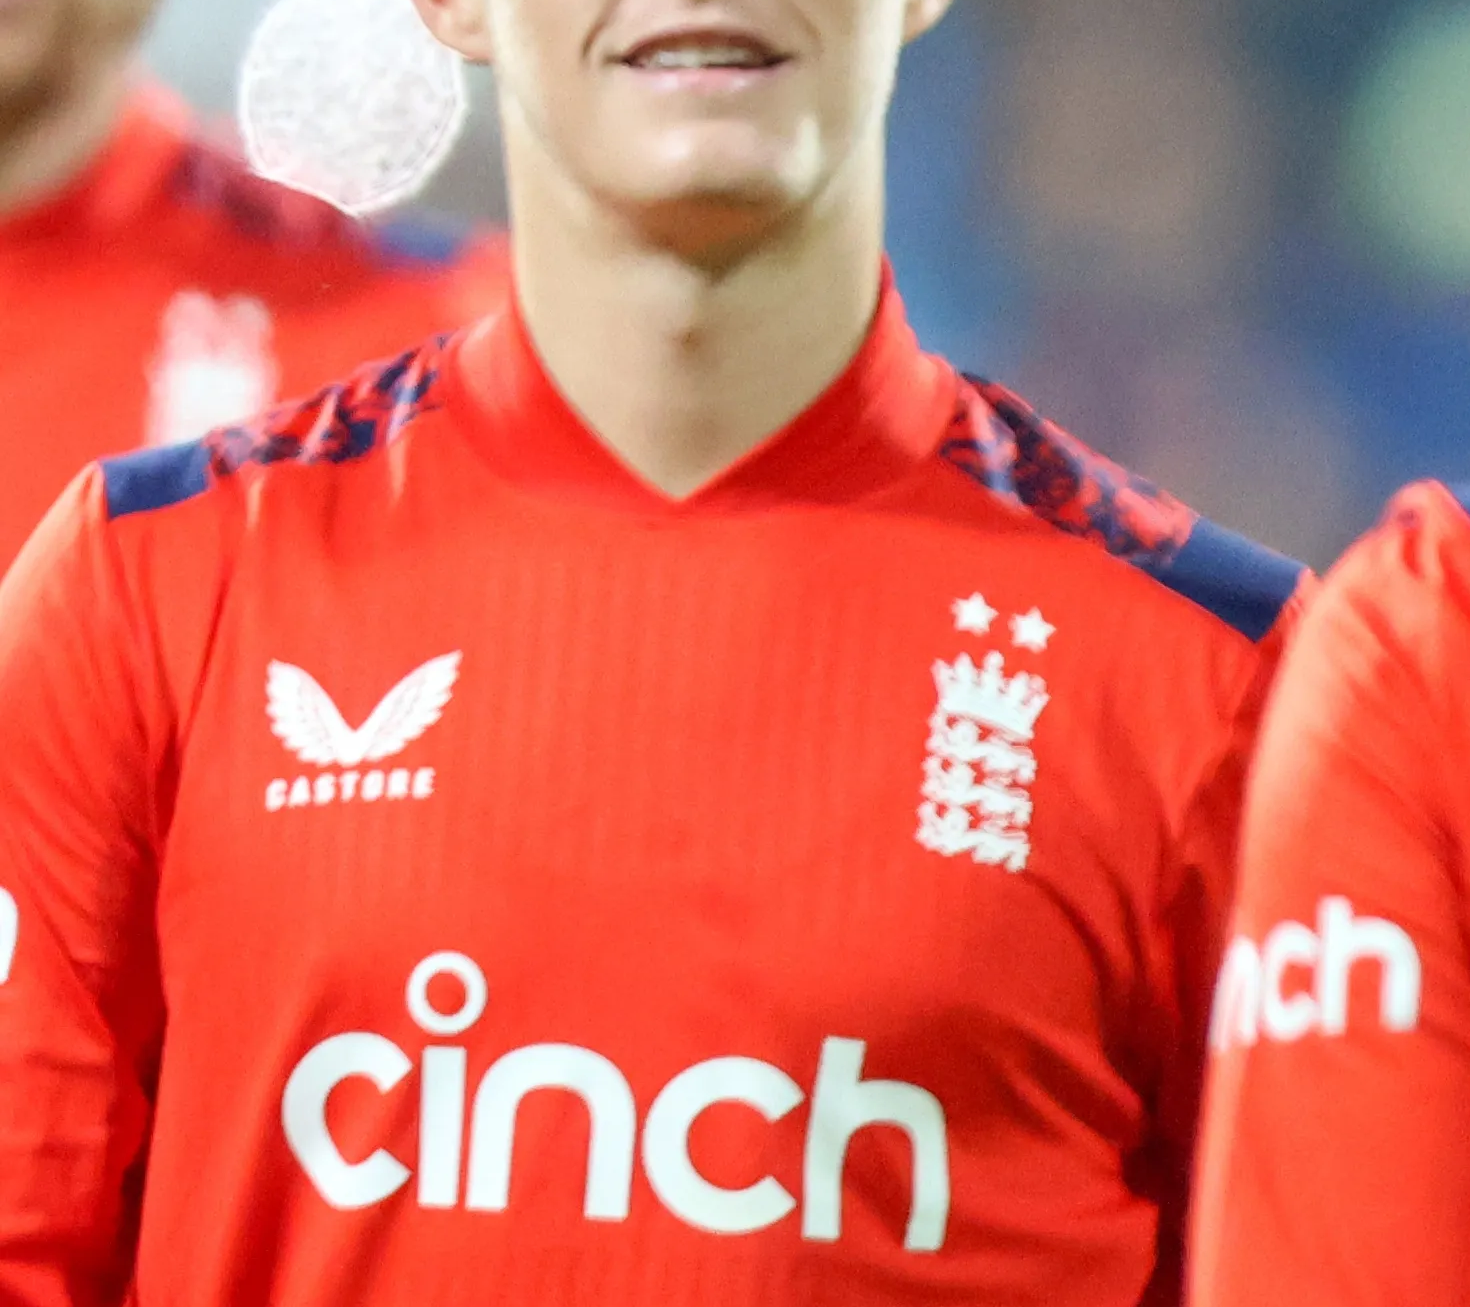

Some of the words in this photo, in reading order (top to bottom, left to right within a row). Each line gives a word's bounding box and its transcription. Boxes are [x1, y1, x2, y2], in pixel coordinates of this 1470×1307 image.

[264, 766, 437, 813] CASTORE
[1208, 895, 1423, 1053] nch
[282, 950, 950, 1253] cinch
